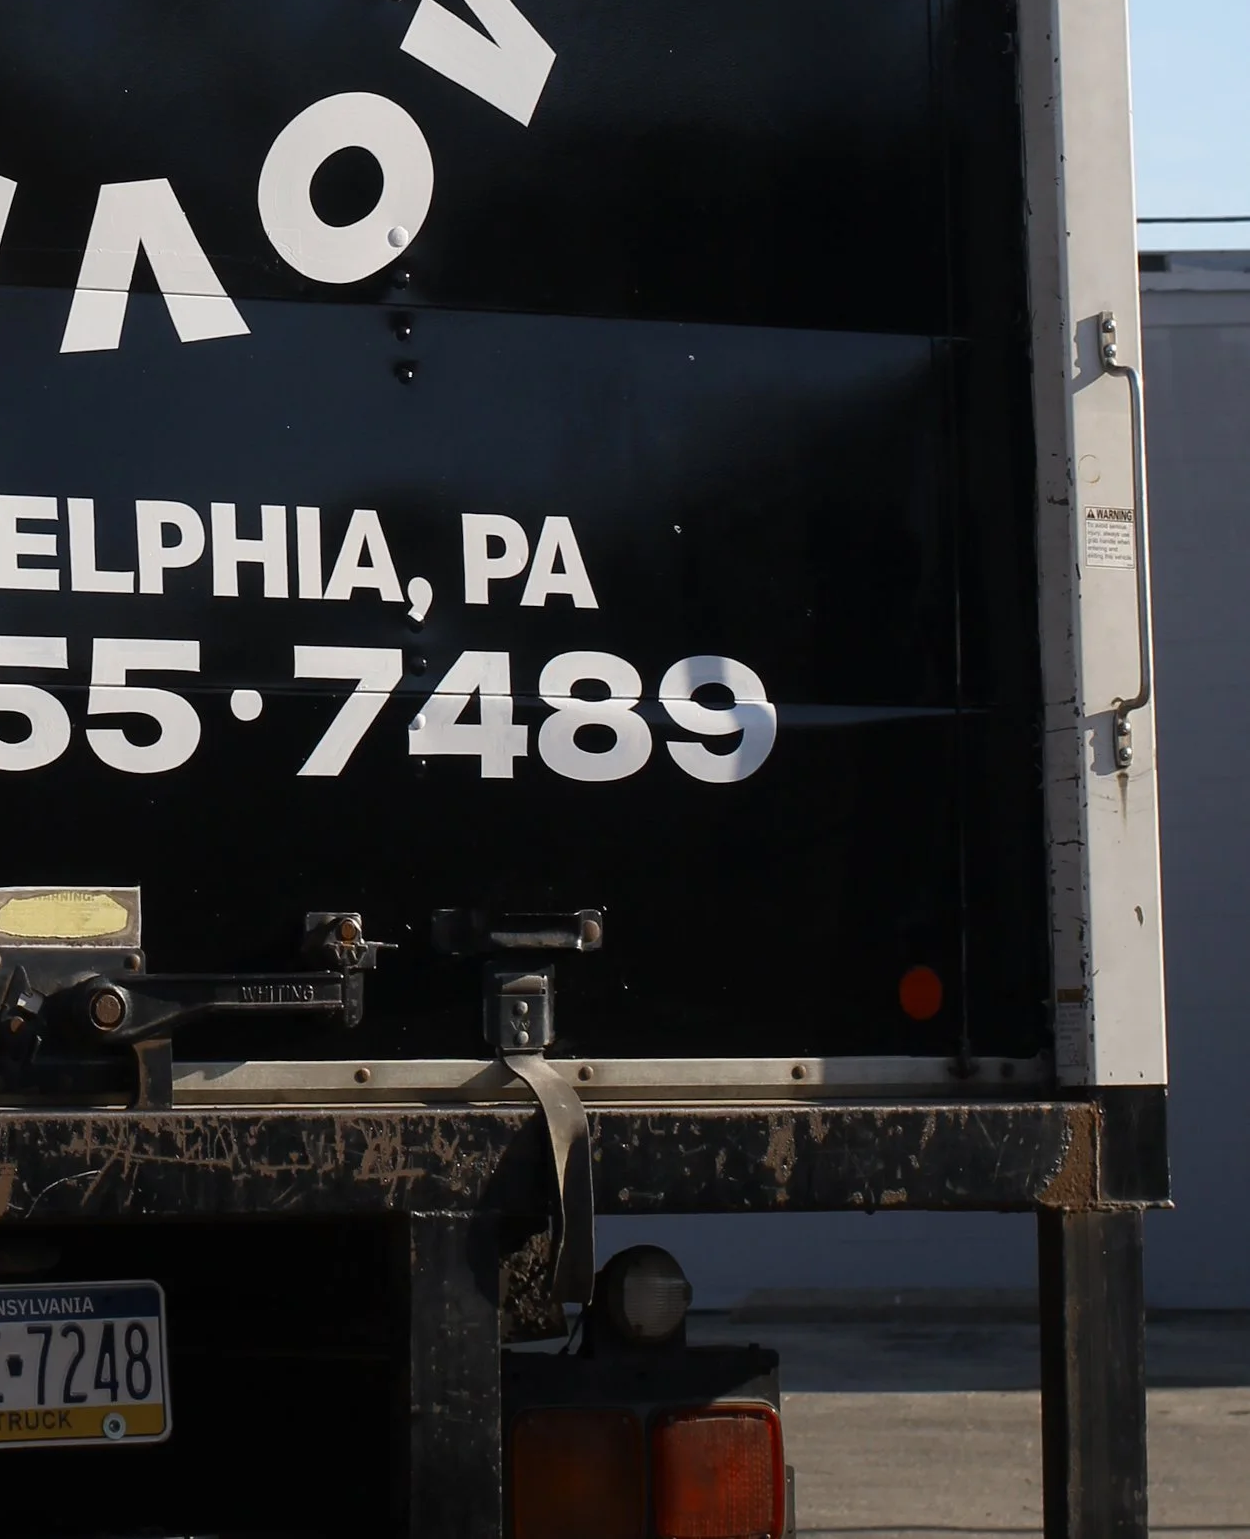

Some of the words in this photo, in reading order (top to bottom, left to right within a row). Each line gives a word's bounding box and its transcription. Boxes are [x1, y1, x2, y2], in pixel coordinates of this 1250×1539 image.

[1096, 509, 1132, 521] WARNING
[462, 514, 598, 608] PA
[242, 984, 315, 1003] WHITING
